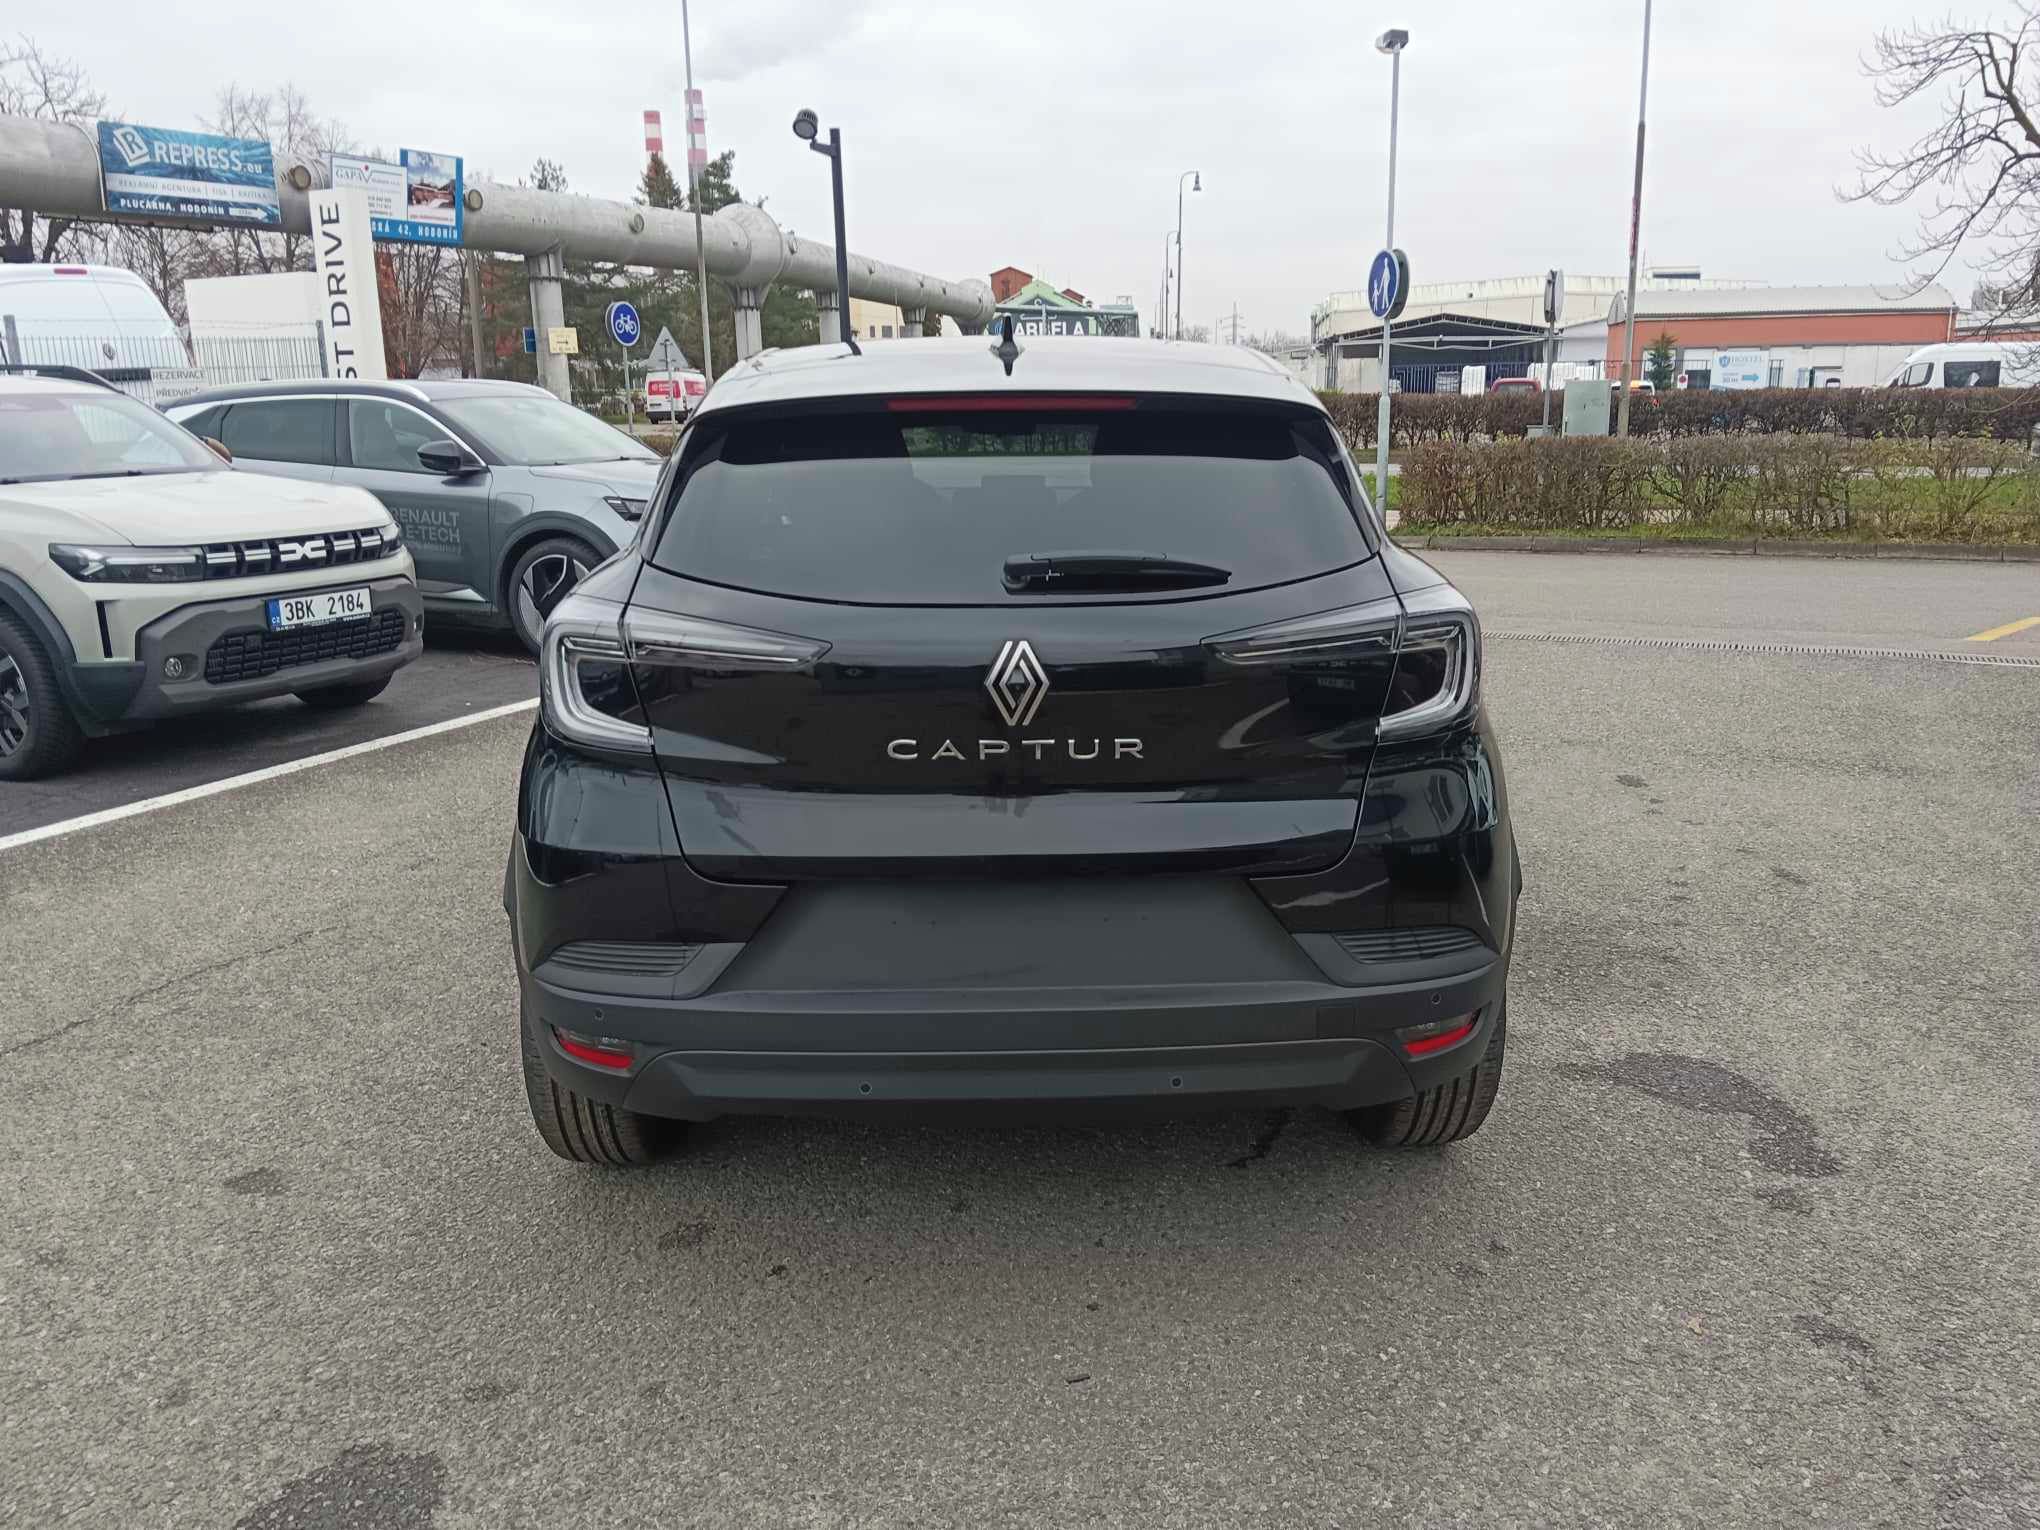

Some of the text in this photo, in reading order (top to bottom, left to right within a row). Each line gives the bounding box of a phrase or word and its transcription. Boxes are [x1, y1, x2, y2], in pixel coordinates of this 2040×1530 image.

[153, 141, 263, 175] REPRESS.eu
[180, 204, 225, 215] HODONÍN
[418, 224, 458, 240] HODONÍN
[320, 203, 351, 328] DRIVE
[285, 599, 315, 622] 3BK
[327, 592, 364, 615] 2184
[887, 738, 1144, 760] CAPTUR
